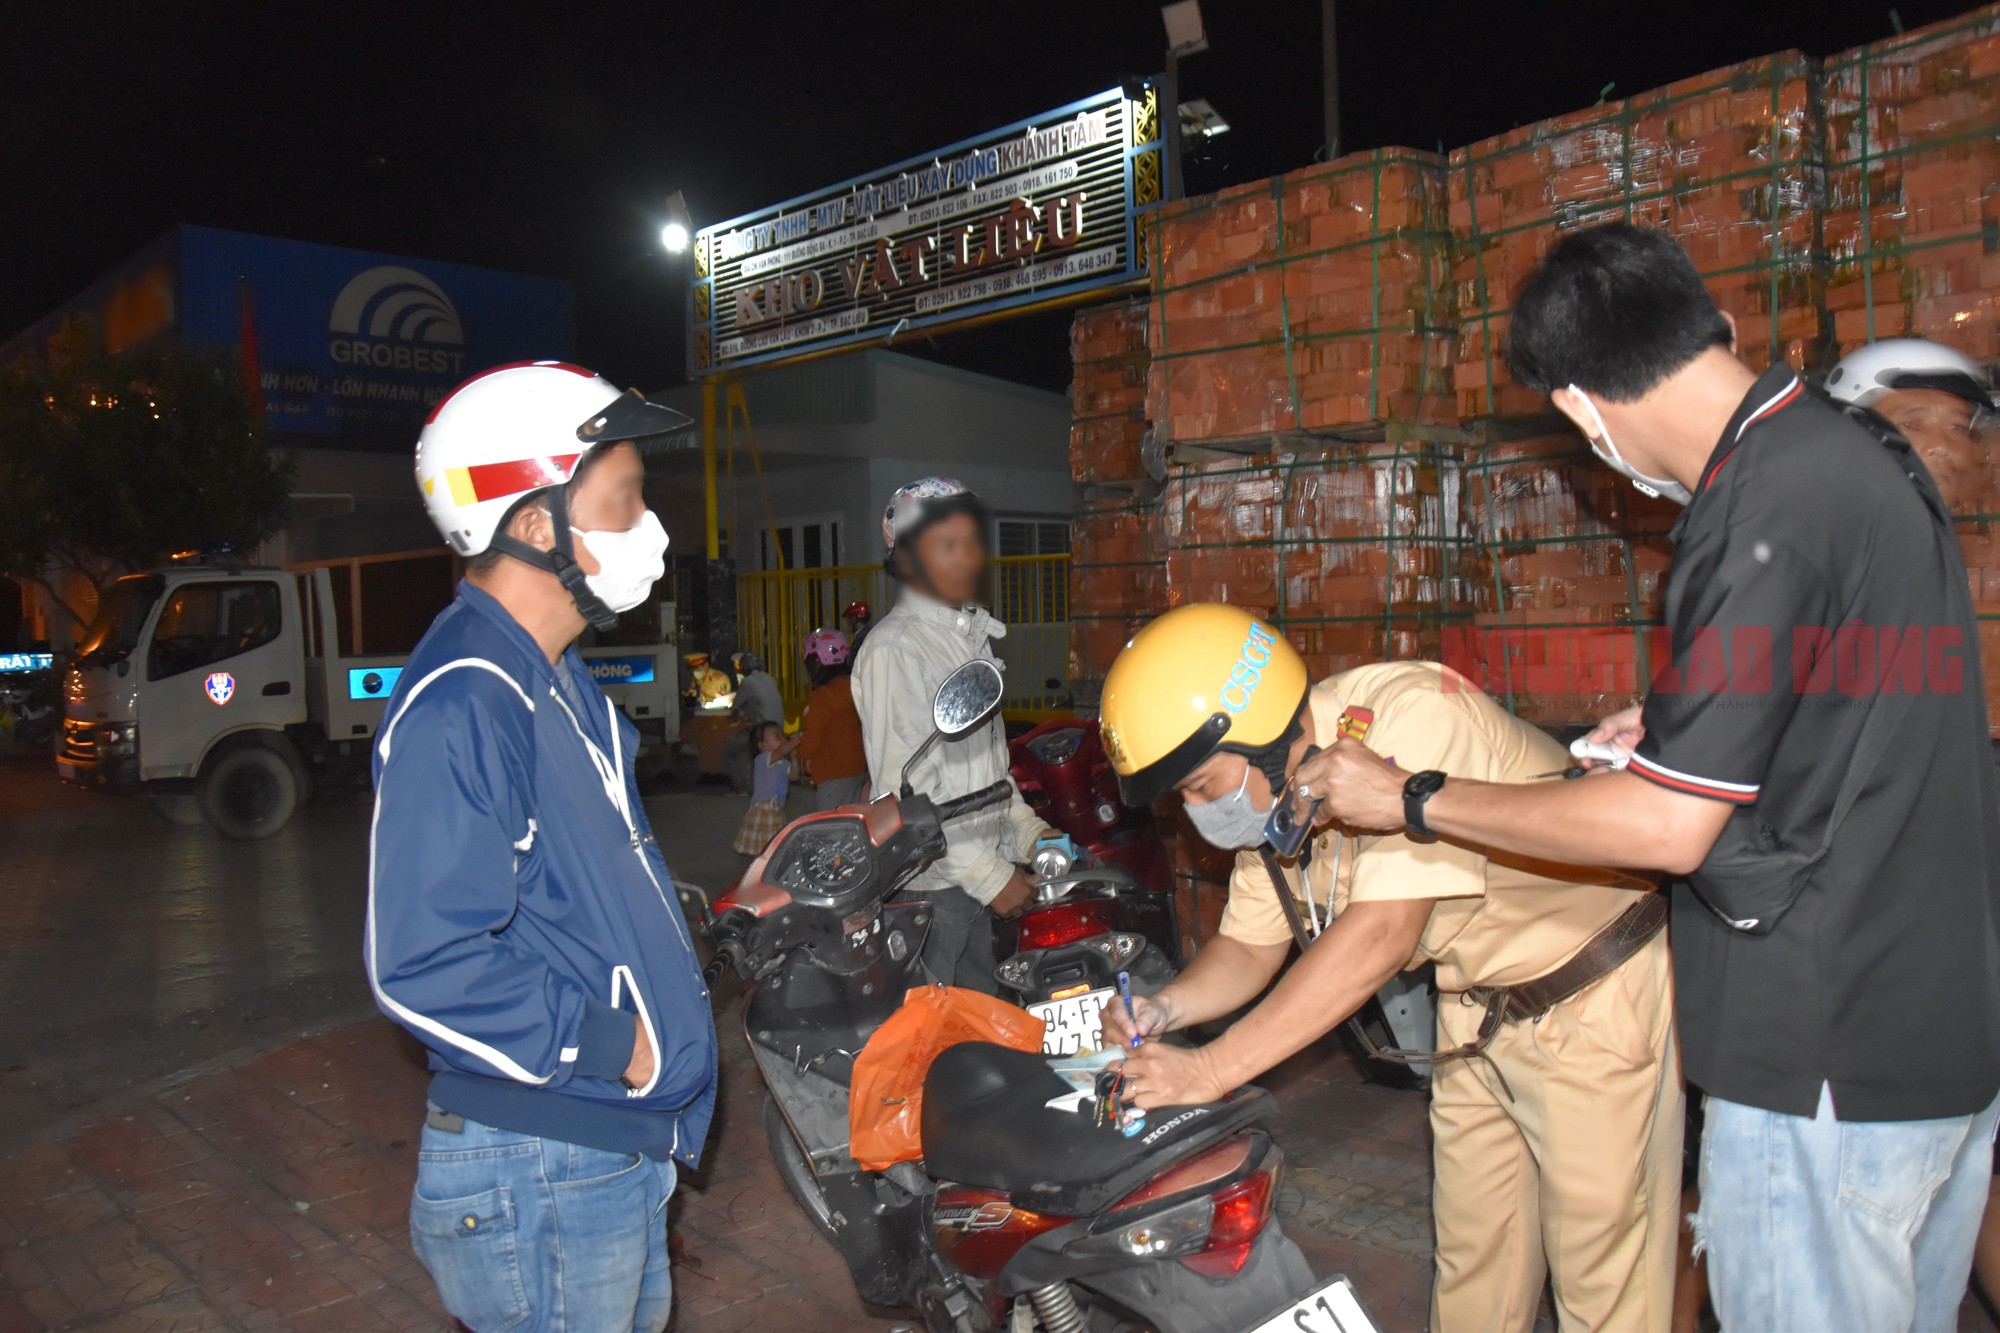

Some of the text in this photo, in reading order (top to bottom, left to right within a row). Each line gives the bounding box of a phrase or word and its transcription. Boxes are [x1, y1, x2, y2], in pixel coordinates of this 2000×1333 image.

[756, 223, 772, 249] TY
[775, 211, 808, 243] TNHH
[817, 199, 845, 231] MTV
[855, 184, 882, 221] VẬT
[885, 172, 917, 211] LIỆU
[920, 161, 951, 197] XÂY
[955, 149, 999, 190] DỰNG
[1002, 127, 1060, 169] KHÁNH
[1067, 112, 1102, 151] TÂM
[956, 197, 968, 212] 106
[973, 191, 989, 207] FAX:
[990, 187, 1003, 200] 822
[1005, 184, 1018, 198] 503
[1022, 176, 1042, 191] 0918.
[1044, 171, 1057, 185] 161
[1059, 166, 1073, 181] 750
[734, 193, 1086, 329] KHO VẬT LIỆU
[958, 287, 971, 300] 922
[974, 282, 987, 295] 798
[993, 278, 1014, 294] 0918.
[1015, 272, 1030, 285] 468
[1032, 267, 1047, 282] 595
[1053, 263, 1077, 278] 0913.
[1078, 256, 1094, 271] 648
[1097, 252, 1112, 267] 347
[330, 339, 465, 374] GROBEST
[262, 372, 280, 391] NH
[367, 382, 421, 402] NHANH
[284, 403, 311, 415] GAP
[589, 662, 632, 679] HÔNG
[1220, 621, 1276, 713] CSGT
[1141, 1108, 1210, 1145] HONDA
